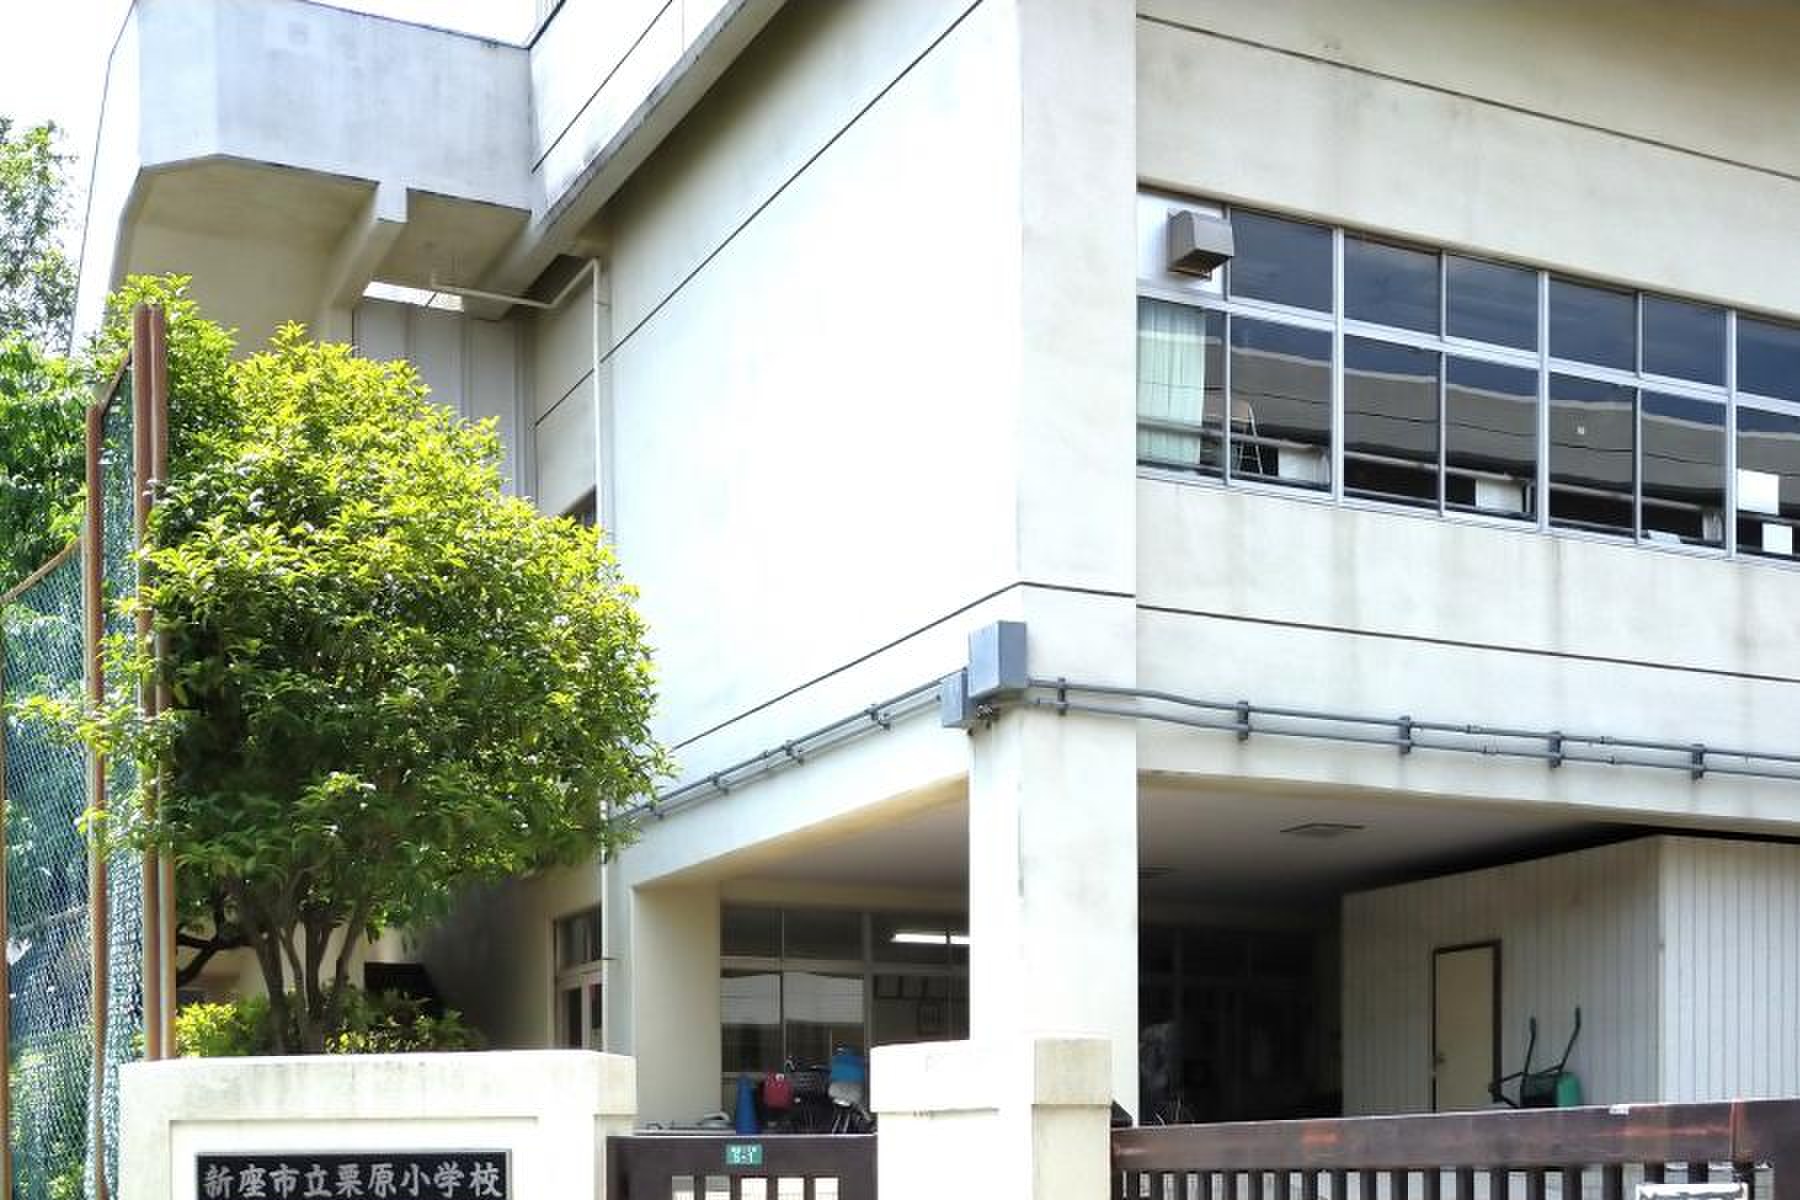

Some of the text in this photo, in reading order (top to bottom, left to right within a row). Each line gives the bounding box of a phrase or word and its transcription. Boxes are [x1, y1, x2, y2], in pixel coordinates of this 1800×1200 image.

[203, 1160, 504, 1199] 新座市立栗原小学校
